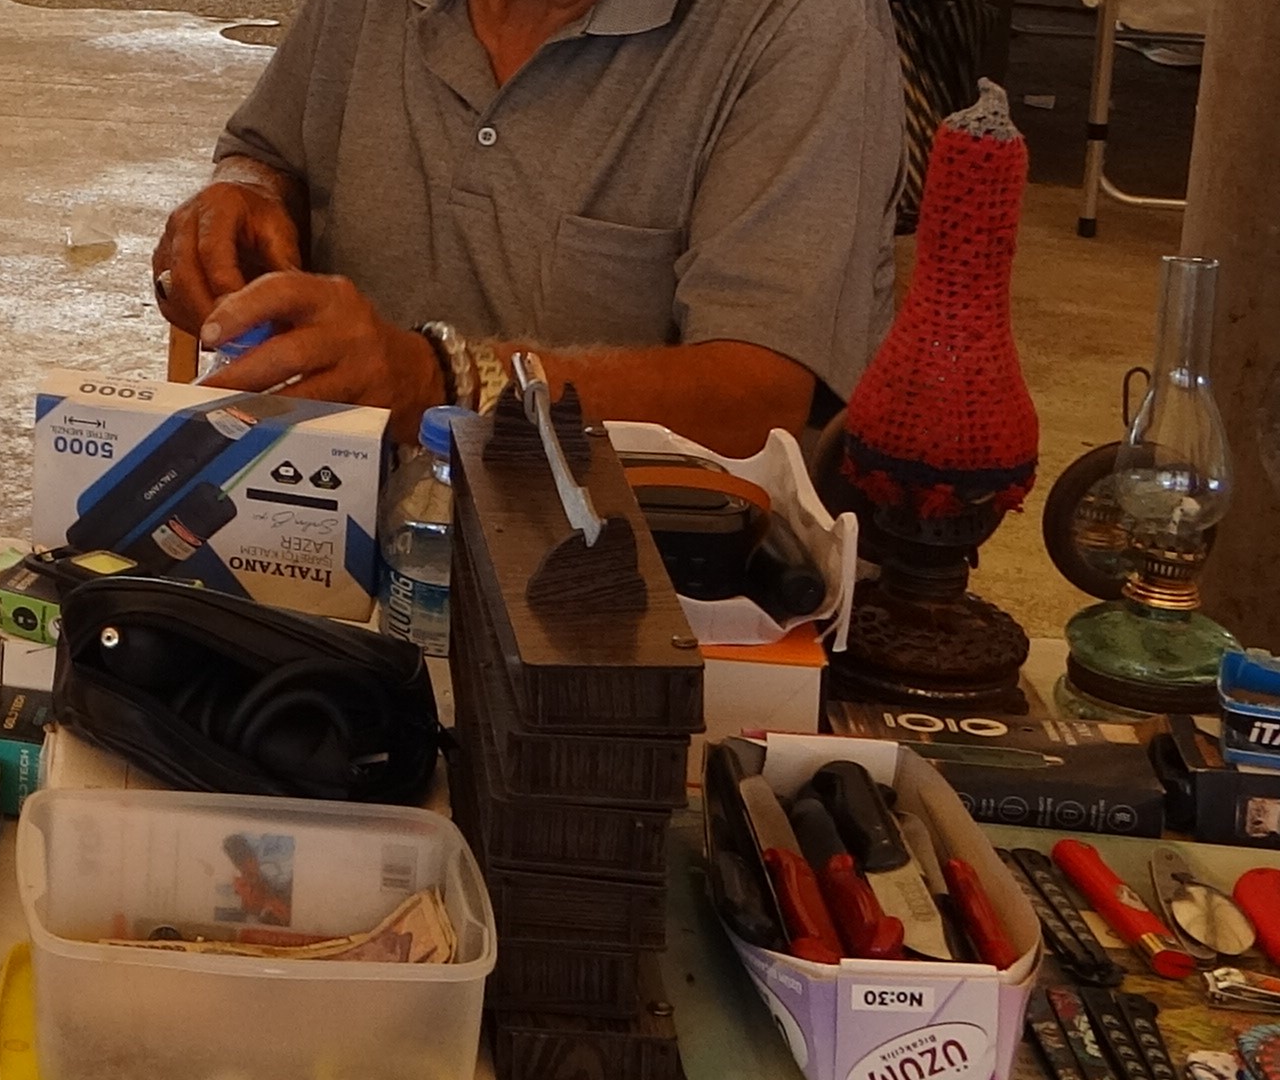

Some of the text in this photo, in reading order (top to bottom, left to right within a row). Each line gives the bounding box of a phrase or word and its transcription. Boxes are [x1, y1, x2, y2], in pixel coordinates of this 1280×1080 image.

[79, 383, 154, 400] 5000
[54, 436, 114, 459] 5000
[280, 535, 333, 555] LAZER
[864, 990, 924, 1007] No:30
